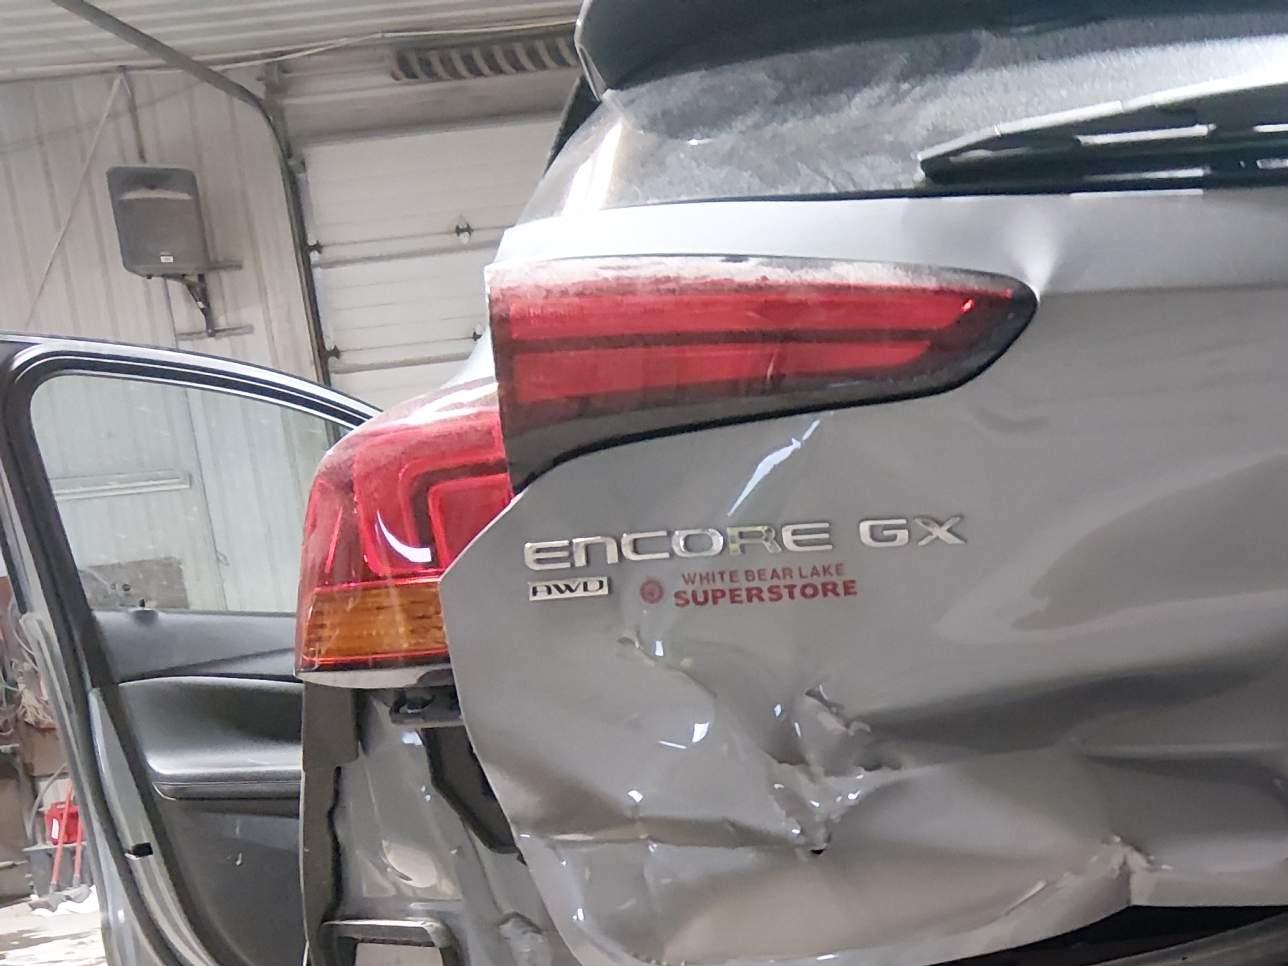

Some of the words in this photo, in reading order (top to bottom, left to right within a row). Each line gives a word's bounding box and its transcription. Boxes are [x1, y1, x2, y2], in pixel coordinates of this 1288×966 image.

[523, 522, 833, 571] ENCORE
[858, 516, 966, 548] GX
[682, 570, 739, 586] WHITE
[745, 566, 793, 583] BEAR
[799, 562, 846, 579] LAKE
[530, 577, 608, 599] AWD
[673, 579, 858, 607] SUPERSTORE
